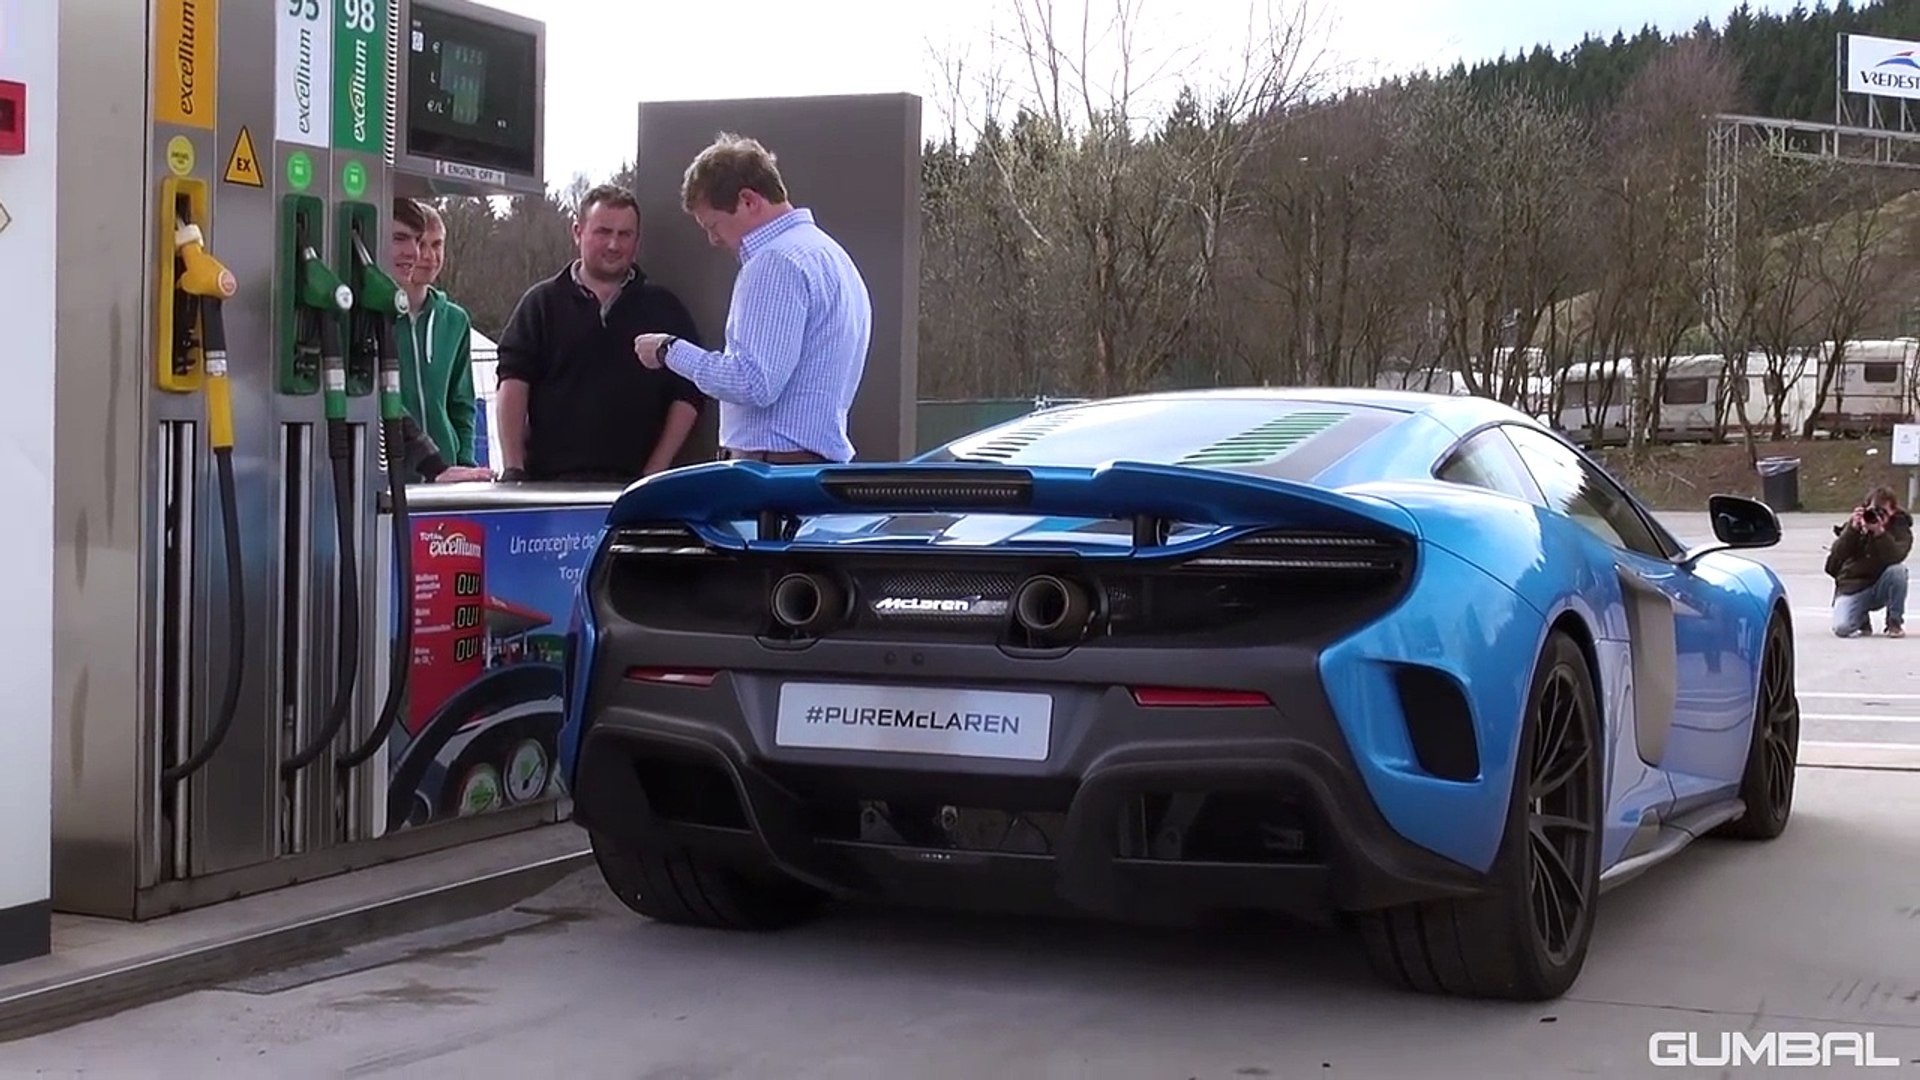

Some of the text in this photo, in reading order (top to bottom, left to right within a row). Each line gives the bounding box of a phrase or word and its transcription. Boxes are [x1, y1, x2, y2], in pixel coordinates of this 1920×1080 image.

[345, 0, 375, 33] 98
[179, 0, 195, 115] excellium
[296, 28, 311, 134] excellium
[351, 38, 367, 142] excellium
[237, 157, 251, 172] EX
[429, 536, 481, 558] excellium
[510, 536, 526, 554] Un
[876, 597, 968, 611] McLaren
[806, 706, 1019, 734] #PUREMcLAREN
